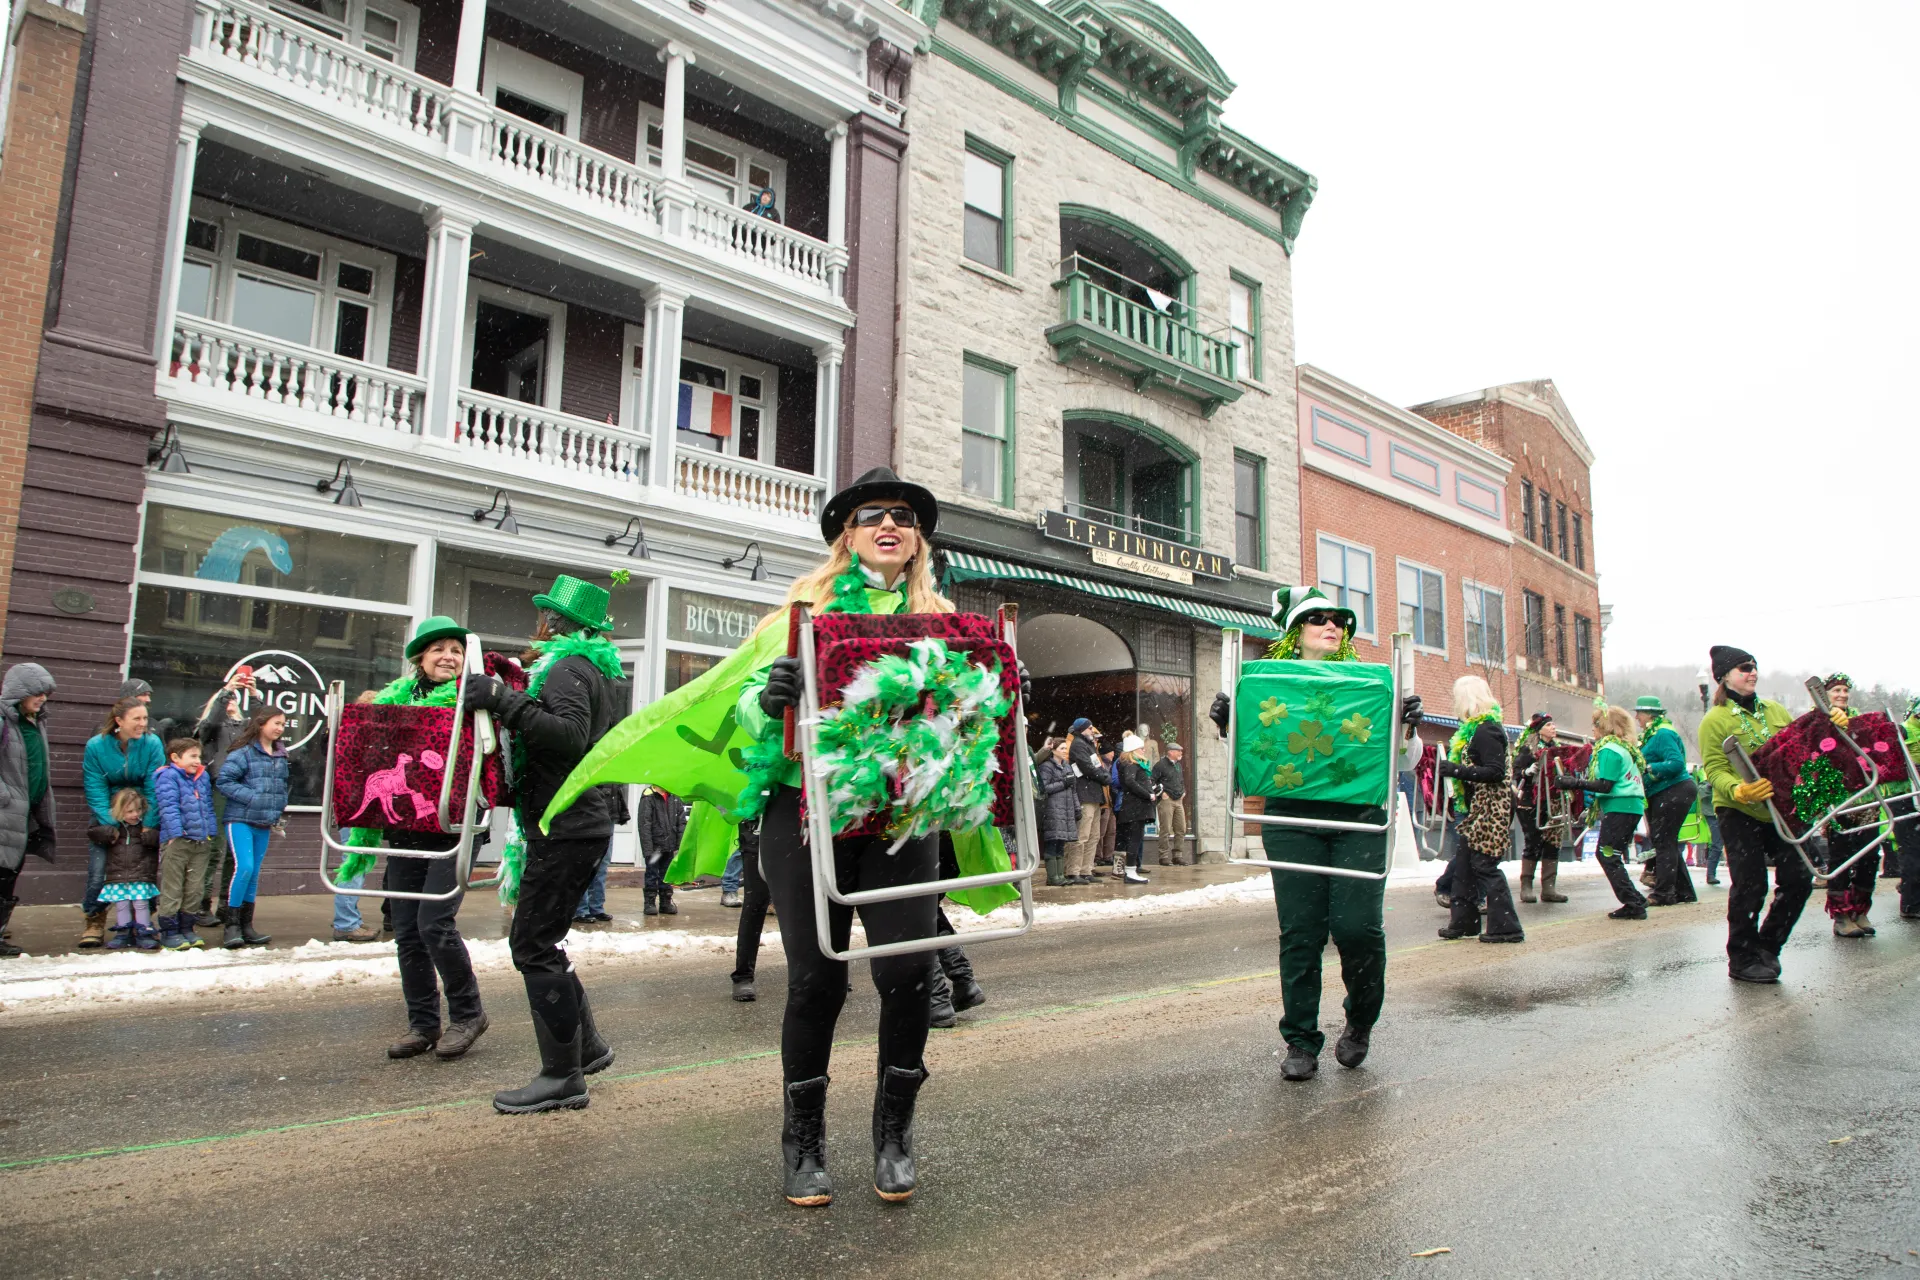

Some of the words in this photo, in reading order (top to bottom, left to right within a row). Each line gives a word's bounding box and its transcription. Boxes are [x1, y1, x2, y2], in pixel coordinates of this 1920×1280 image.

[1066, 518, 1080, 540] T.
[1088, 525, 1101, 545] F.
[1108, 530, 1222, 575] FINNIGAN
[1116, 557, 1140, 572] Quality
[1142, 563, 1170, 578] Clothing
[686, 604, 758, 638] BICYCLE
